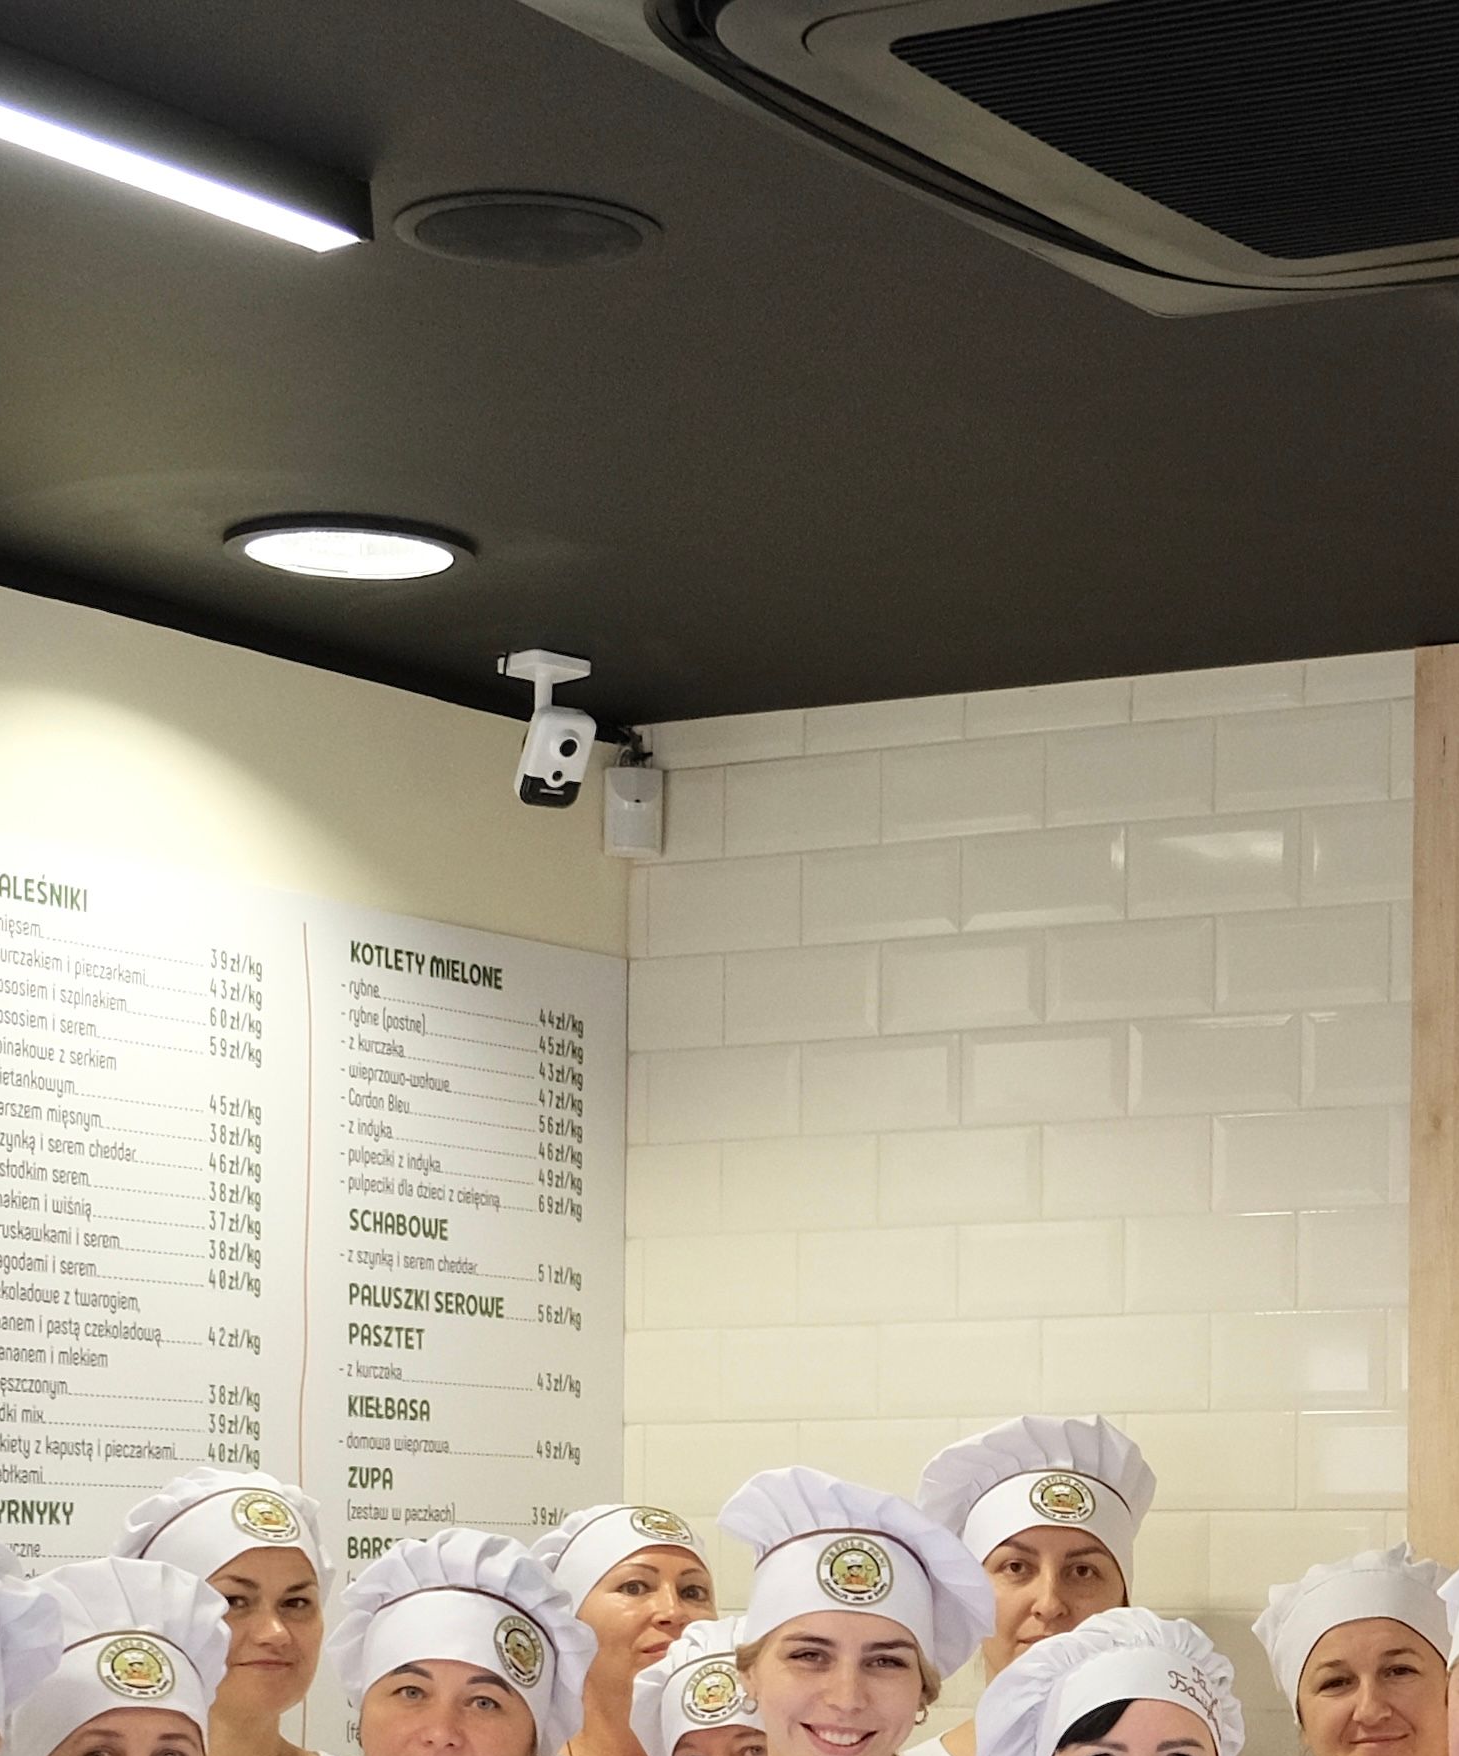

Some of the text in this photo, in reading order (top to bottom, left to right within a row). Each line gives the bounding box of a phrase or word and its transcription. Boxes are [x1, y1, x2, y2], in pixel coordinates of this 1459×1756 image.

[74, 958, 147, 986] pieczarkami
[350, 941, 502, 989] KOTLETY MIELONE
[59, 988, 128, 1011] szpinakiem
[349, 978, 381, 1000] rybne
[59, 1018, 98, 1037] serem
[348, 1005, 427, 1036] rybne (postne)
[357, 1033, 406, 1058] kurczaka
[69, 1048, 117, 1070] serkiem
[348, 1087, 385, 1110] Cordon
[387, 1093, 411, 1114] Bleu
[46, 1105, 103, 1132] mięsnym
[357, 1118, 394, 1142] indyka
[47, 1137, 85, 1155] serem
[88, 1139, 138, 1162] cheddar
[348, 1145, 442, 1176] pulpeciki indyka
[52, 1168, 90, 1187] serem
[348, 1173, 395, 1195] pulpeciki
[397, 1178, 414, 1197] dla
[416, 1181, 446, 1201] dzieci
[51, 1196, 92, 1222] wiśnią
[349, 1208, 448, 1240] SCHABOWE
[83, 1232, 122, 1249] serem
[59, 1260, 98, 1277] serem
[356, 1248, 479, 1276] szynką serem cheddar
[348, 1283, 430, 1311] PALUSZKI
[434, 1291, 504, 1318] SEROWE
[46, 1318, 80, 1341] pastą
[84, 1320, 163, 1346] czekoladową
[348, 1322, 425, 1349] PASZTET
[57, 1346, 108, 1367] mlekiem
[355, 1360, 403, 1381] kurczaka
[21, 1405, 45, 1424] mix
[348, 1395, 430, 1421] KIEŁBASA
[45, 1435, 93, 1461] kapustą
[104, 1440, 177, 1461] pieczarkami
[346, 1432, 391, 1451] domowa
[347, 1466, 393, 1490] ZUPA
[391, 1507, 402, 1521] w
